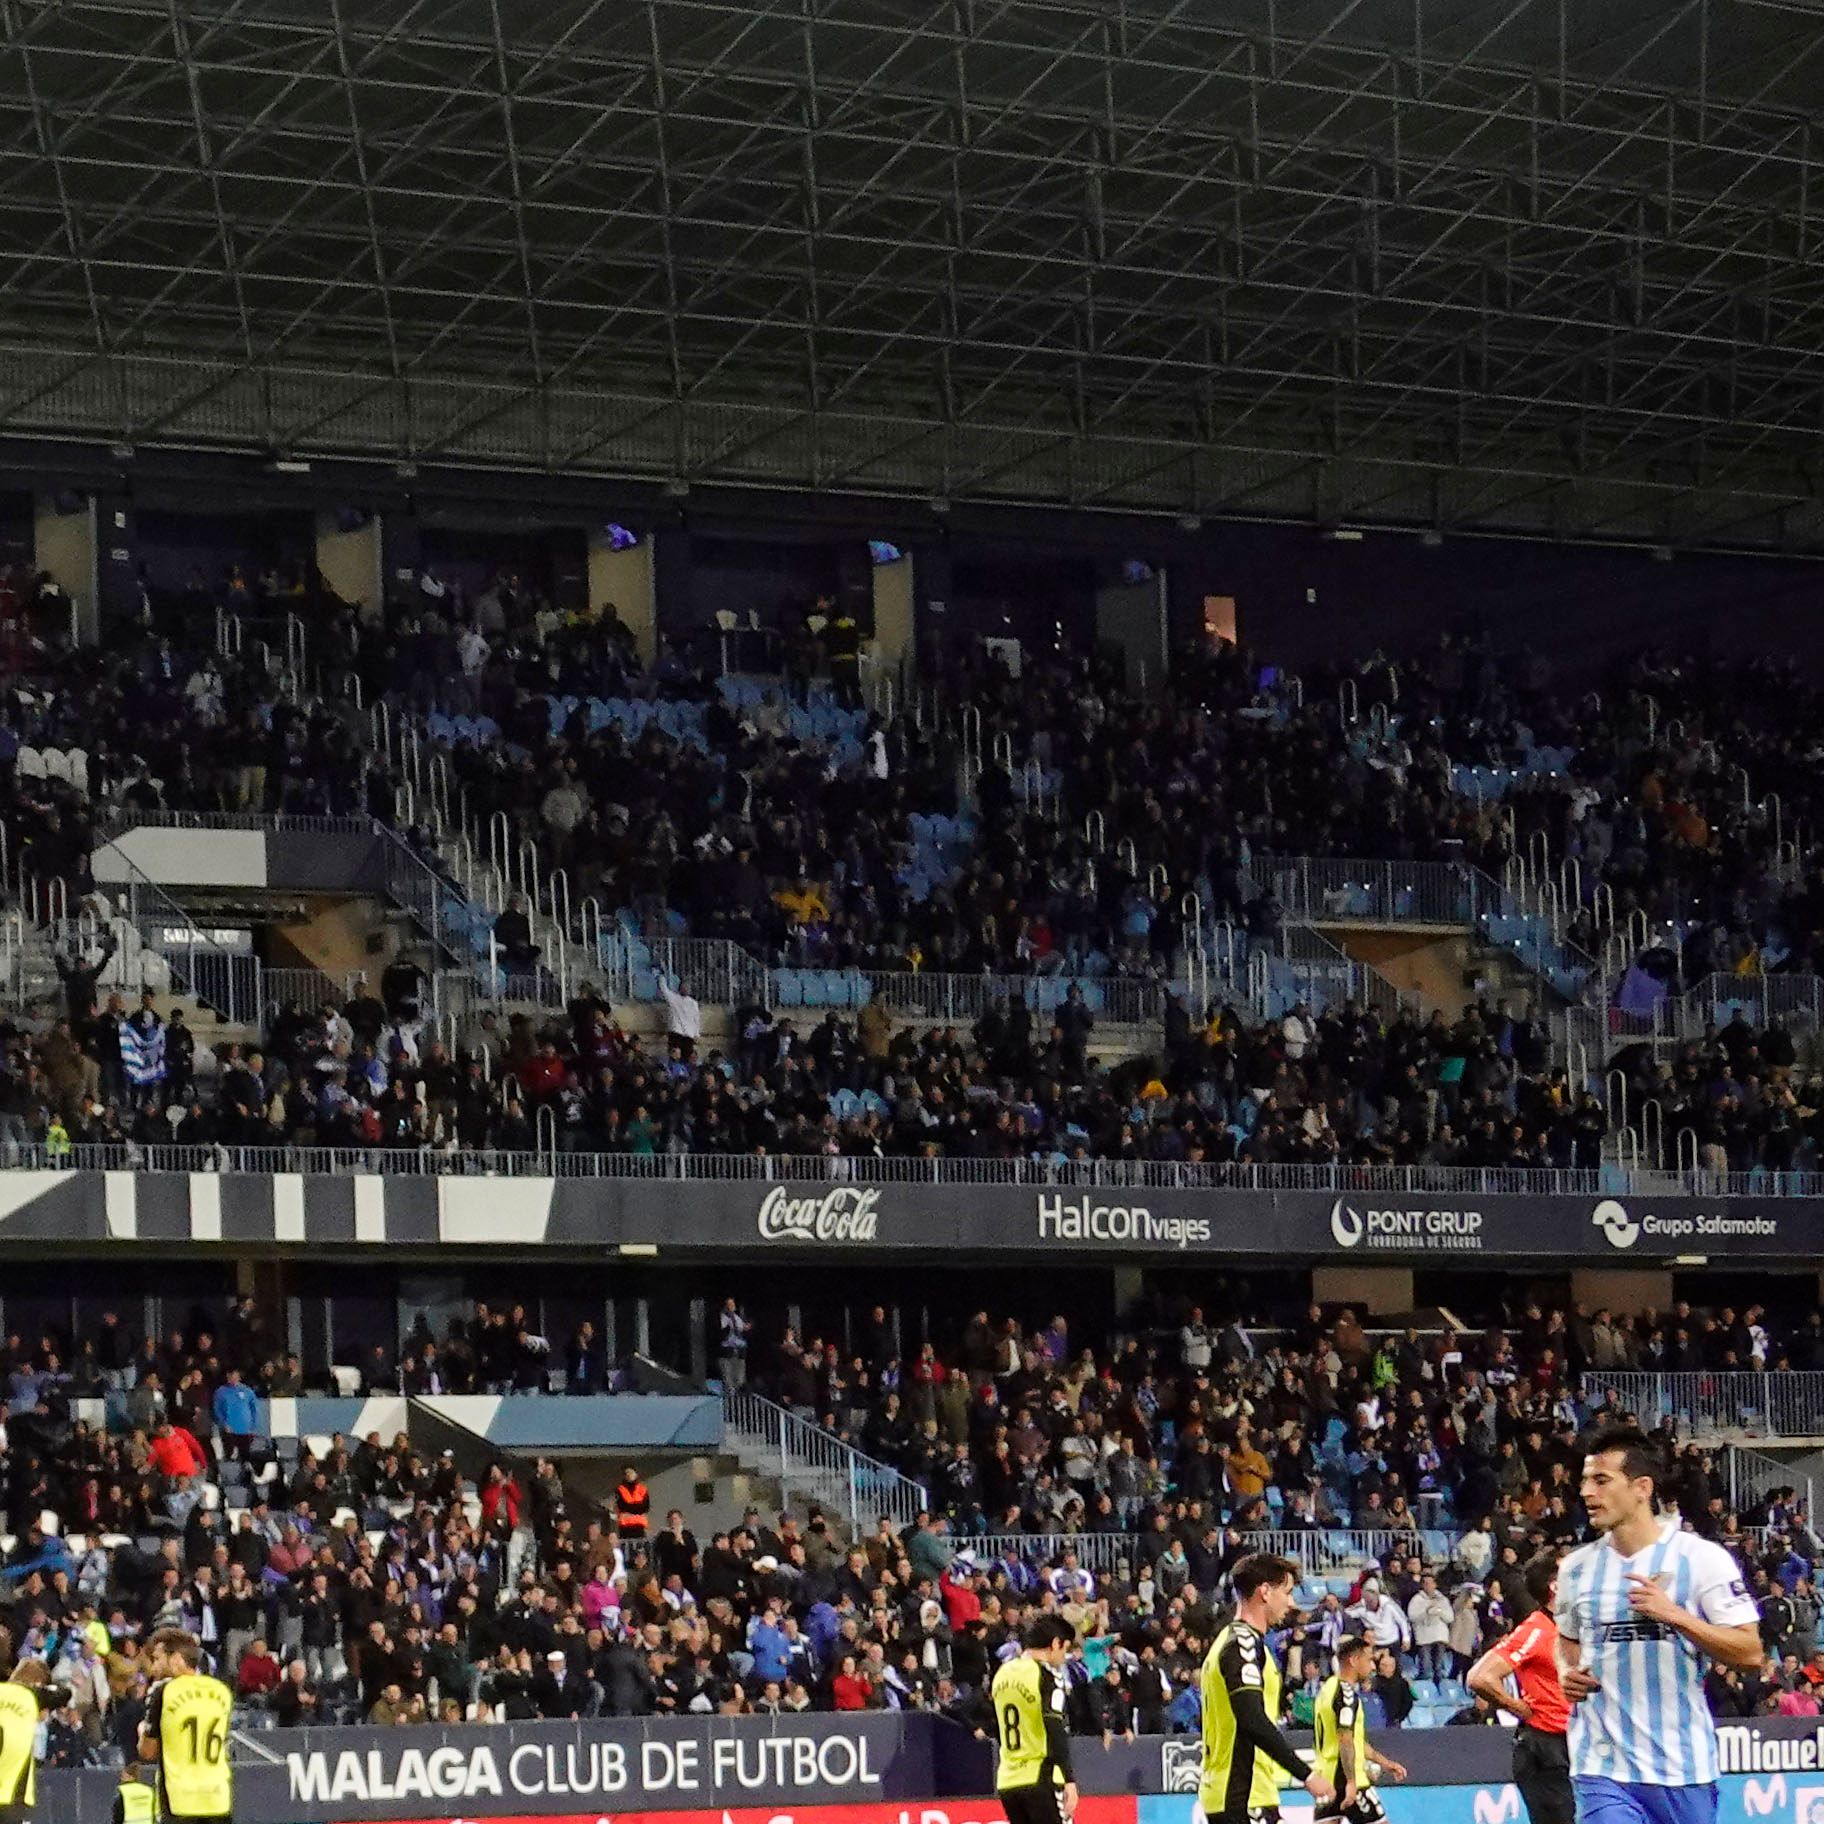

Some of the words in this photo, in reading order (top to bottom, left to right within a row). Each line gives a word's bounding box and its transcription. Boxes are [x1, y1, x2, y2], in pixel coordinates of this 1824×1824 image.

[757, 1186, 882, 1241] Coca-Cola
[1366, 1210, 1422, 1233] PONT
[1426, 1212, 1483, 1234] GRUP
[1643, 1214, 1693, 1237] Grupo
[1696, 1214, 1776, 1236] Safamotor
[180, 1716, 223, 1765] 16
[1003, 1702, 1021, 1751] 8
[287, 1746, 503, 1802] MALAGA
[509, 1742, 628, 1795] CLUB
[641, 1740, 700, 1791] DE
[714, 1735, 880, 1788] FUTBOL
